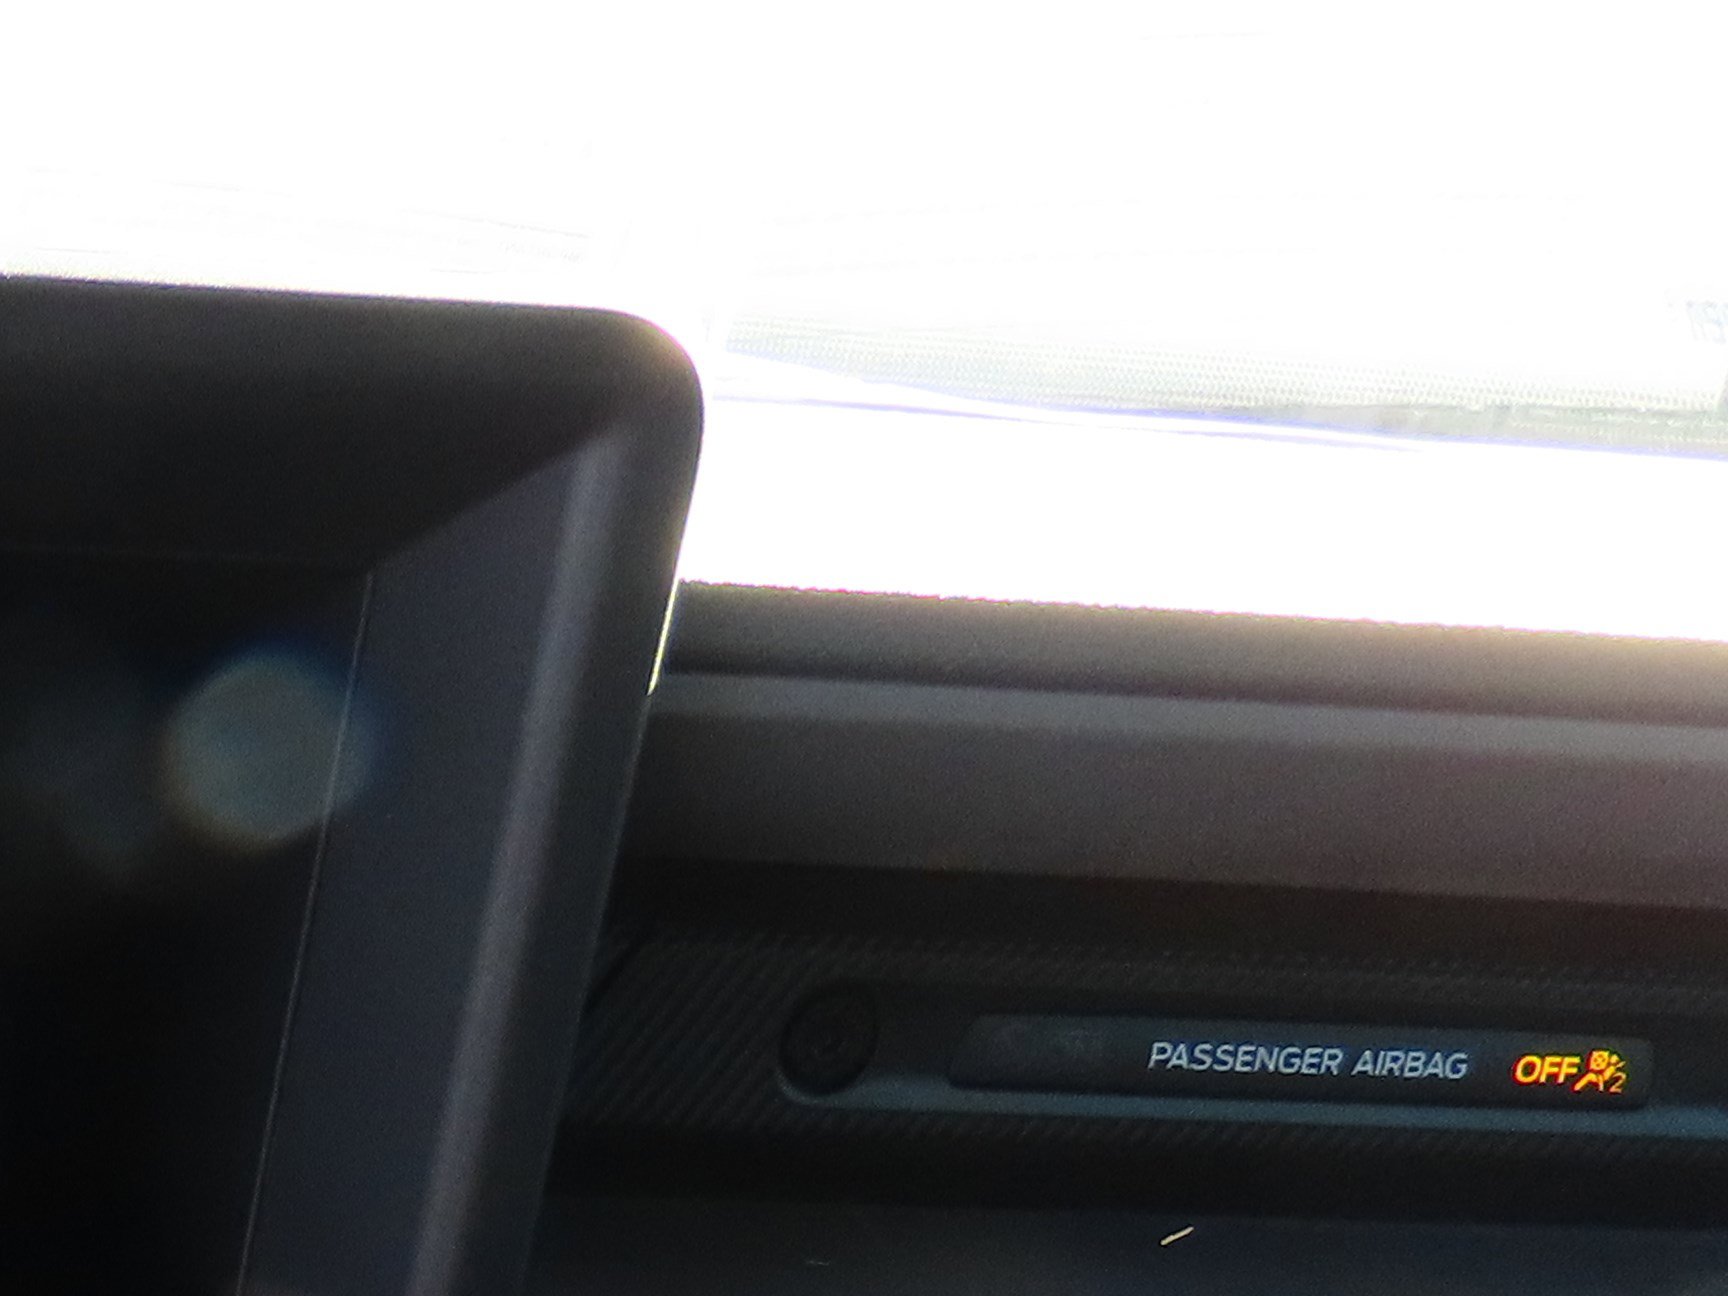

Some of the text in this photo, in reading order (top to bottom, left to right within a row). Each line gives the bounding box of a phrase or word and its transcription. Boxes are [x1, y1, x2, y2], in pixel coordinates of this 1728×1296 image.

[1148, 1041, 1582, 1085] PASSENGER AIRBAG OFF
